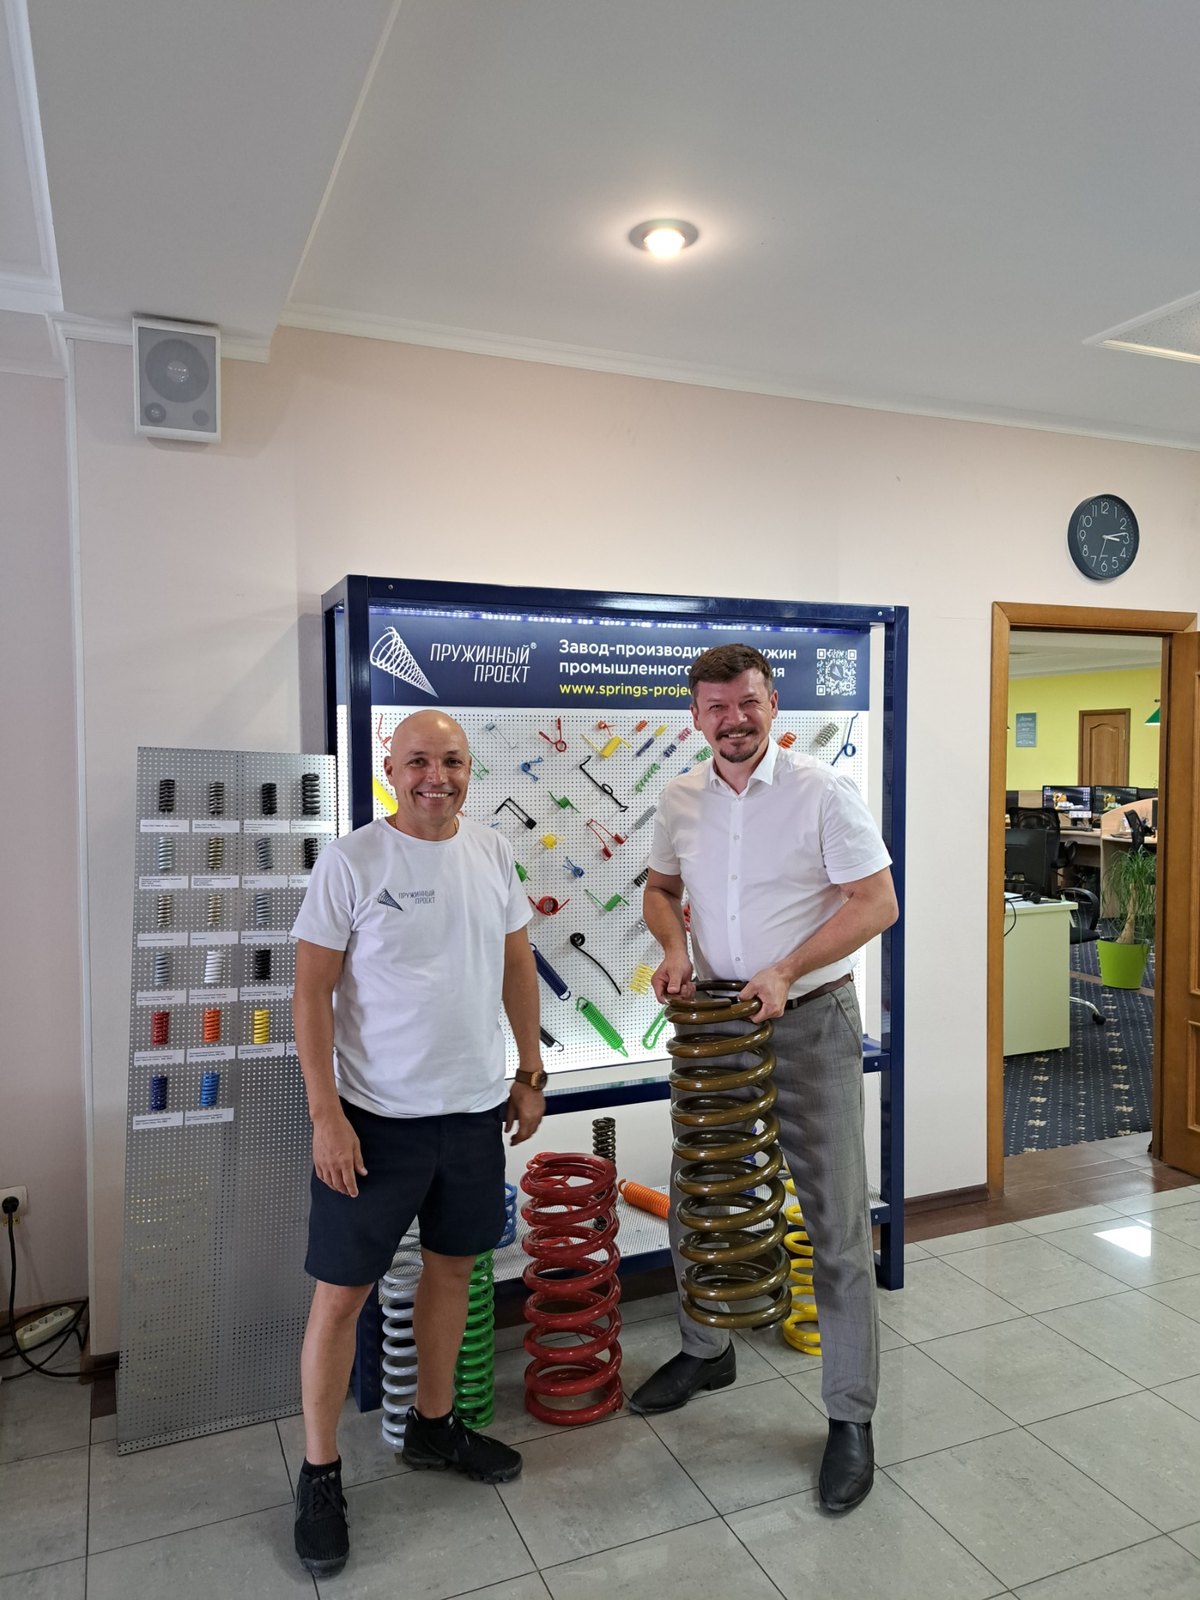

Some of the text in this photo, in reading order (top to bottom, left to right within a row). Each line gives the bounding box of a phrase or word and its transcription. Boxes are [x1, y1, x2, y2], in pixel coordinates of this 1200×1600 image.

[1091, 505, 1097, 517] 11
[1101, 501, 1109, 514] 12
[1081, 515, 1092, 527] 10
[1120, 517, 1127, 530] 2
[1079, 529, 1086, 541] 9
[1122, 532, 1130, 544] 3
[1082, 544, 1088, 556] 8
[1120, 547, 1126, 558] 4
[1090, 555, 1097, 567] 7
[1100, 560, 1108, 572] 6
[1112, 556, 1119, 568] 5
[559, 639, 797, 660] Завод-производит ужин
[474, 664, 531, 683] ПРОЕКТ
